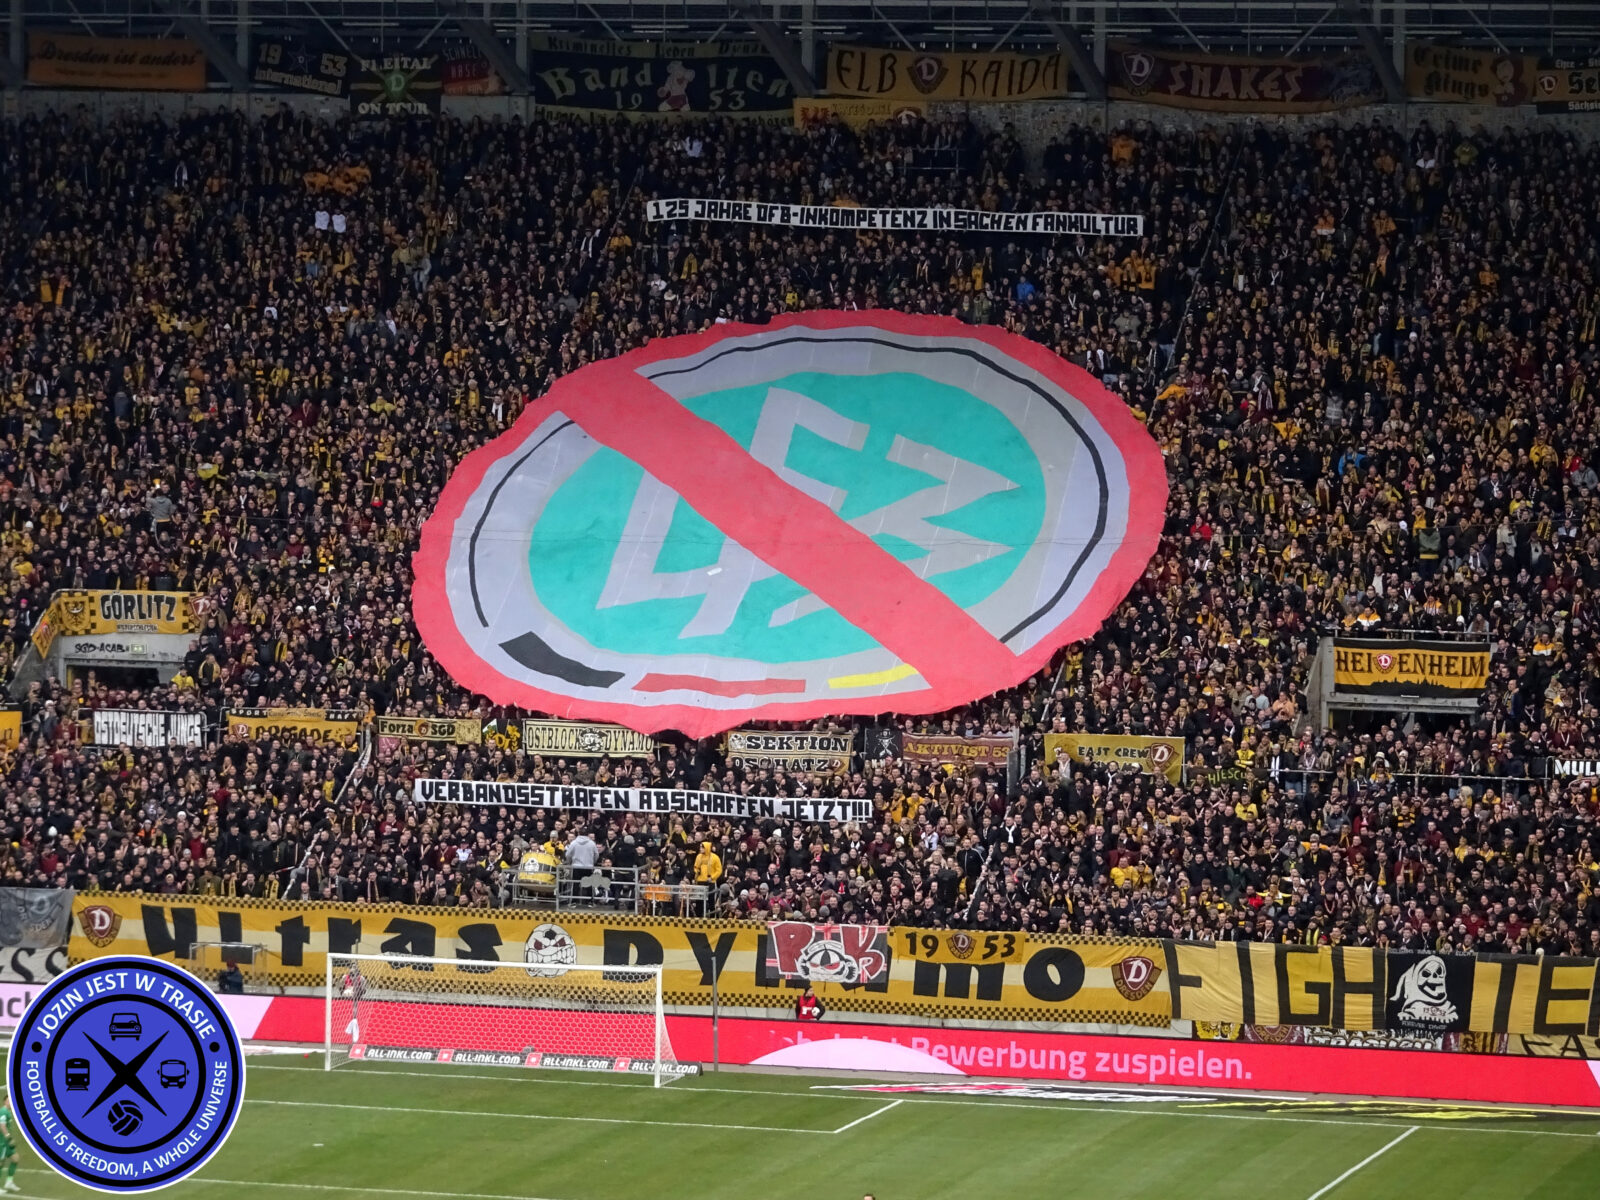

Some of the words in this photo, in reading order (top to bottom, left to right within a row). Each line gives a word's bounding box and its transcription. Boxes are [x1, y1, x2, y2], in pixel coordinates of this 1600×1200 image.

[259, 42, 282, 65] 19
[320, 53, 349, 78] 53
[836, 49, 898, 93] ELB
[959, 53, 1062, 97] KAIDA
[1168, 62, 1304, 103] SNAKES
[358, 103, 380, 115] ON
[386, 102, 430, 116] TOUR
[615, 91, 643, 111] 19
[708, 90, 746, 111] 53
[651, 200, 689, 219] 125
[694, 201, 752, 220] JAHRE
[756, 203, 928, 230] DFB-INKOMPETENZ
[932, 210, 951, 229] IN
[954, 210, 1029, 231] SACHEN
[1031, 213, 1139, 236] FANKULTUR
[380, 720, 415, 735] Forza
[430, 723, 456, 736] SGD
[527, 726, 581, 749] OSTBLOCK
[604, 729, 654, 752] DYNAMO
[746, 735, 849, 752] SEKTION
[903, 742, 989, 759] AKTIVIST
[1078, 745, 1110, 757] EAST
[1114, 747, 1150, 759] CREW
[1555, 760, 1600, 777] MUL
[421, 780, 630, 809] VERBANDSSTRAFEN
[640, 789, 775, 818] ABSCHAFFEN
[781, 799, 870, 820] JETZT!!!
[905, 931, 940, 959] 19
[981, 933, 1016, 960] 53
[912, 1036, 1087, 1080] Bewerbung
[1095, 1048, 1253, 1083] zuspielen.
